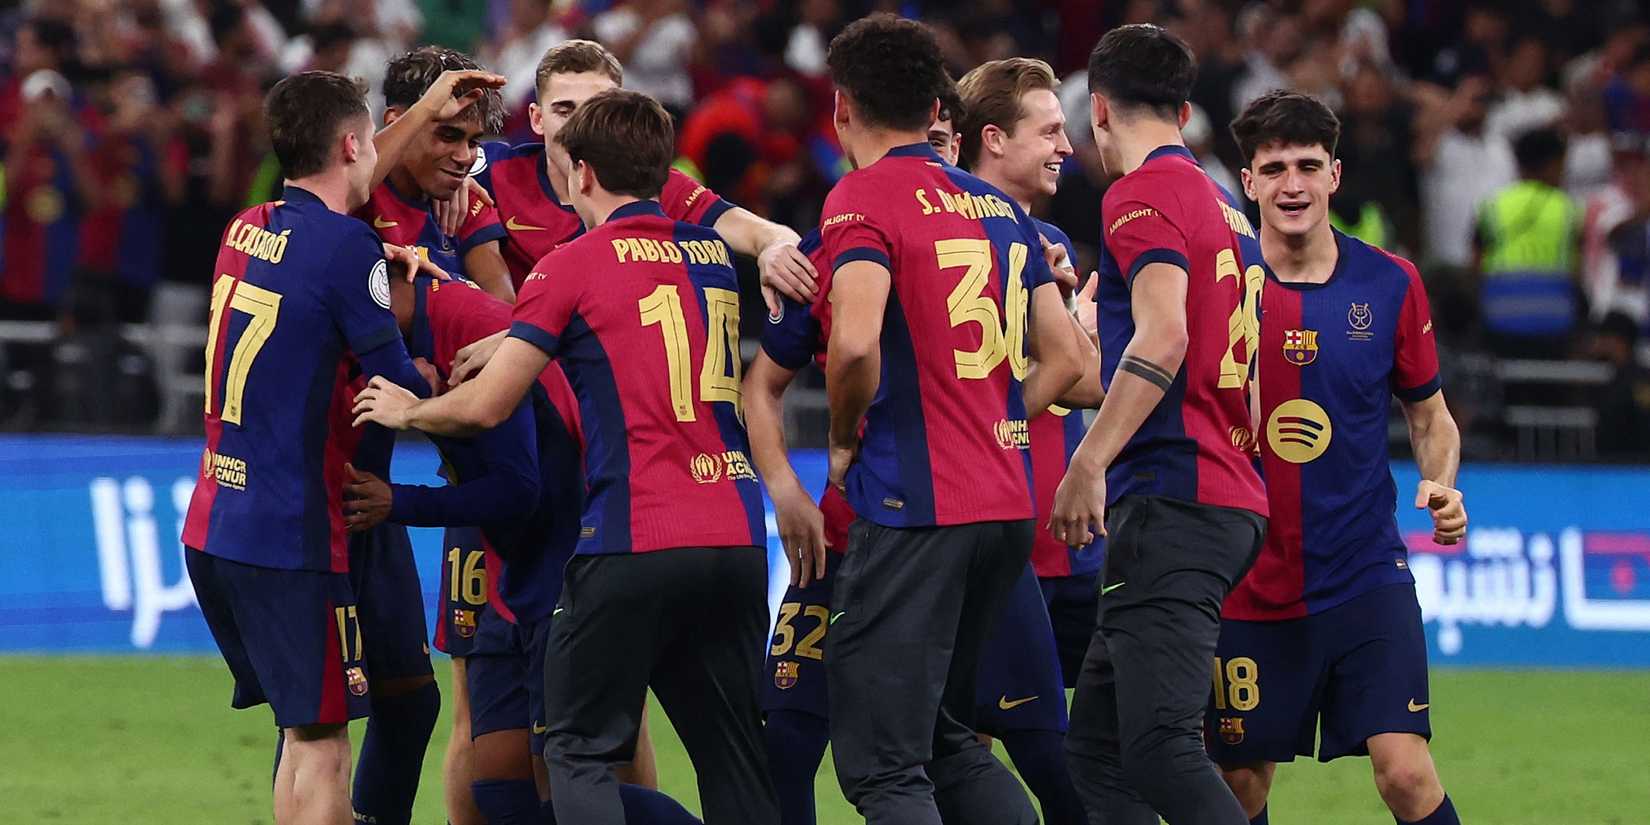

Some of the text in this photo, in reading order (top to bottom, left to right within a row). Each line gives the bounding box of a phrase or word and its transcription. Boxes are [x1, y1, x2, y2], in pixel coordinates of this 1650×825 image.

[611, 238, 733, 269] PABLO TORR
[204, 273, 284, 427] 17
[638, 284, 746, 430] 14
[214, 467, 247, 486] CNUR
[448, 547, 488, 605] 16
[771, 602, 829, 660] 32
[1213, 656, 1260, 711] 18
